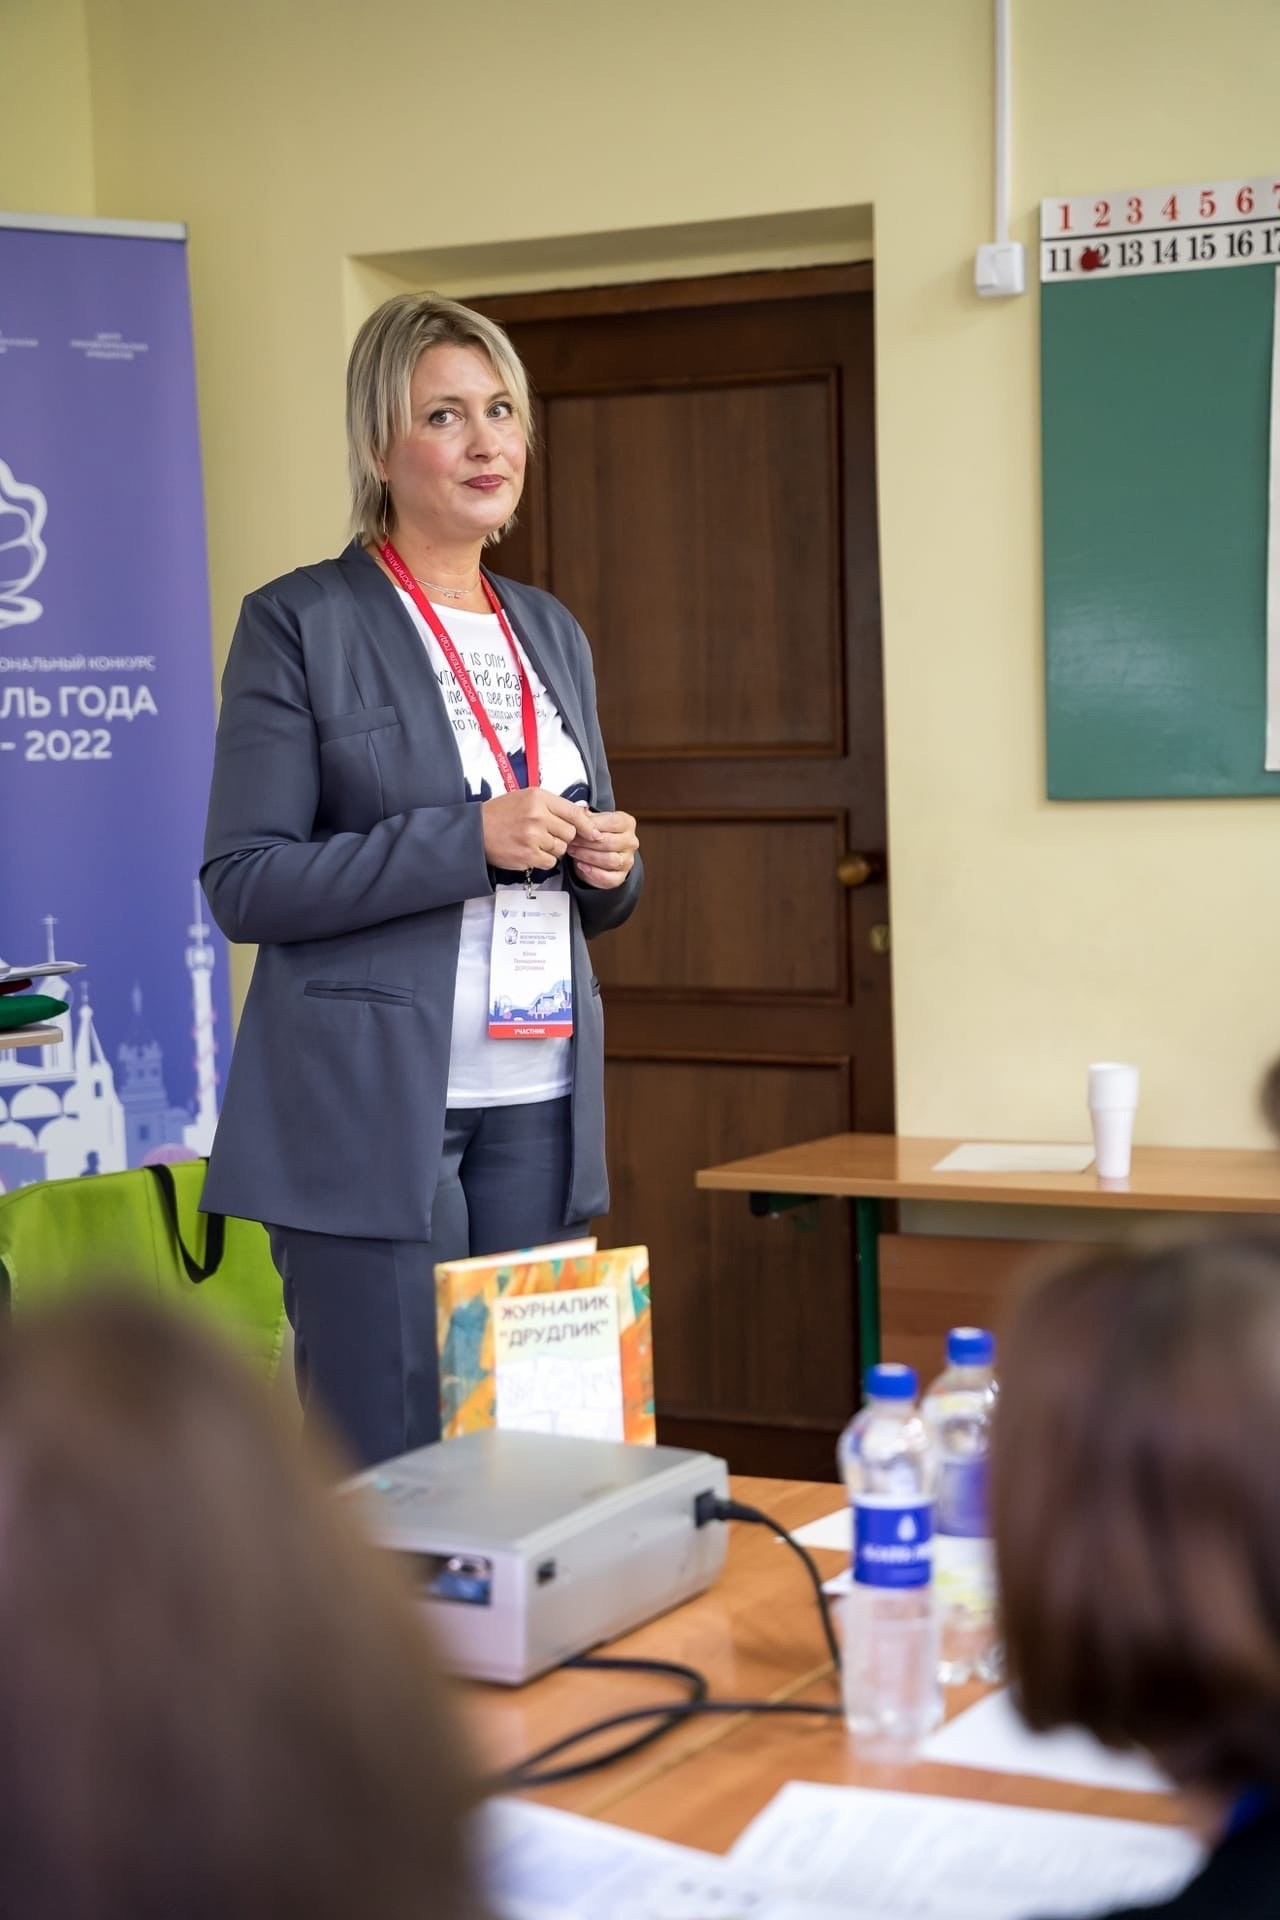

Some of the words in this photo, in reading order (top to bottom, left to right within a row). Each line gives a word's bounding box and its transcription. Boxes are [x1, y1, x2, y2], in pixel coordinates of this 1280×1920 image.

[1059, 203, 1071, 231] 1
[1095, 201, 1110, 228] 2
[1127, 197, 1143, 224] 3
[1162, 194, 1178, 221] 4
[1199, 190, 1216, 217] 5
[1236, 187, 1254, 214] 6
[1049, 248, 1072, 272] 11
[1119, 240, 1144, 268] 13
[1153, 238, 1178, 265] 14
[1188, 234, 1216, 262] 15
[1226, 230, 1254, 258] 16
[88, 655, 156, 672] КОНКУРС
[59, 685, 159, 722] ГОДА
[25, 729, 112, 761] 2022
